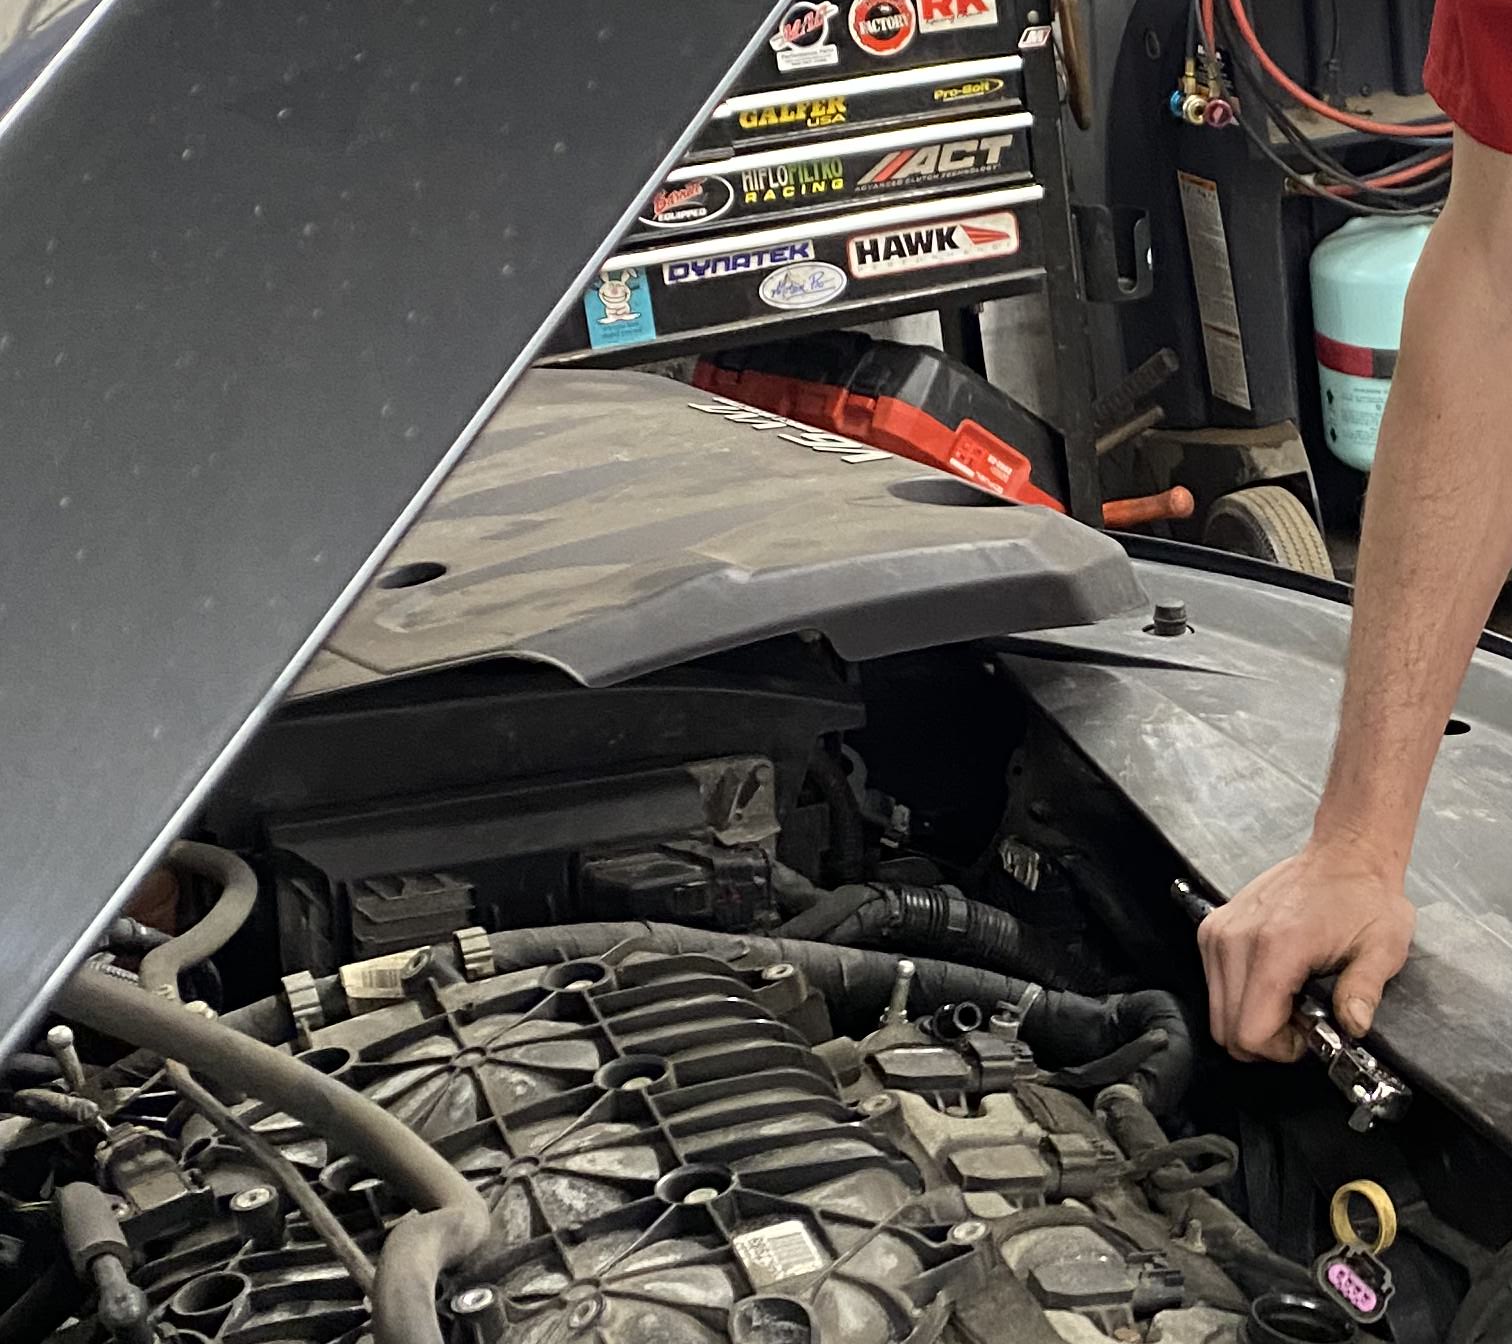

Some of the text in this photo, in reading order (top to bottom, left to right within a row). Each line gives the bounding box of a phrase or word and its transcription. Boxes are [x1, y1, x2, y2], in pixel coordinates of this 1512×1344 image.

[934, 80, 990, 101] Pro-Bolt
[739, 96, 847, 129] GALFER
[806, 114, 846, 128] USA
[886, 135, 1013, 181] ACT
[745, 178, 844, 204] RACING
[668, 241, 810, 281] DYNATEK
[854, 225, 960, 265] HAWK
